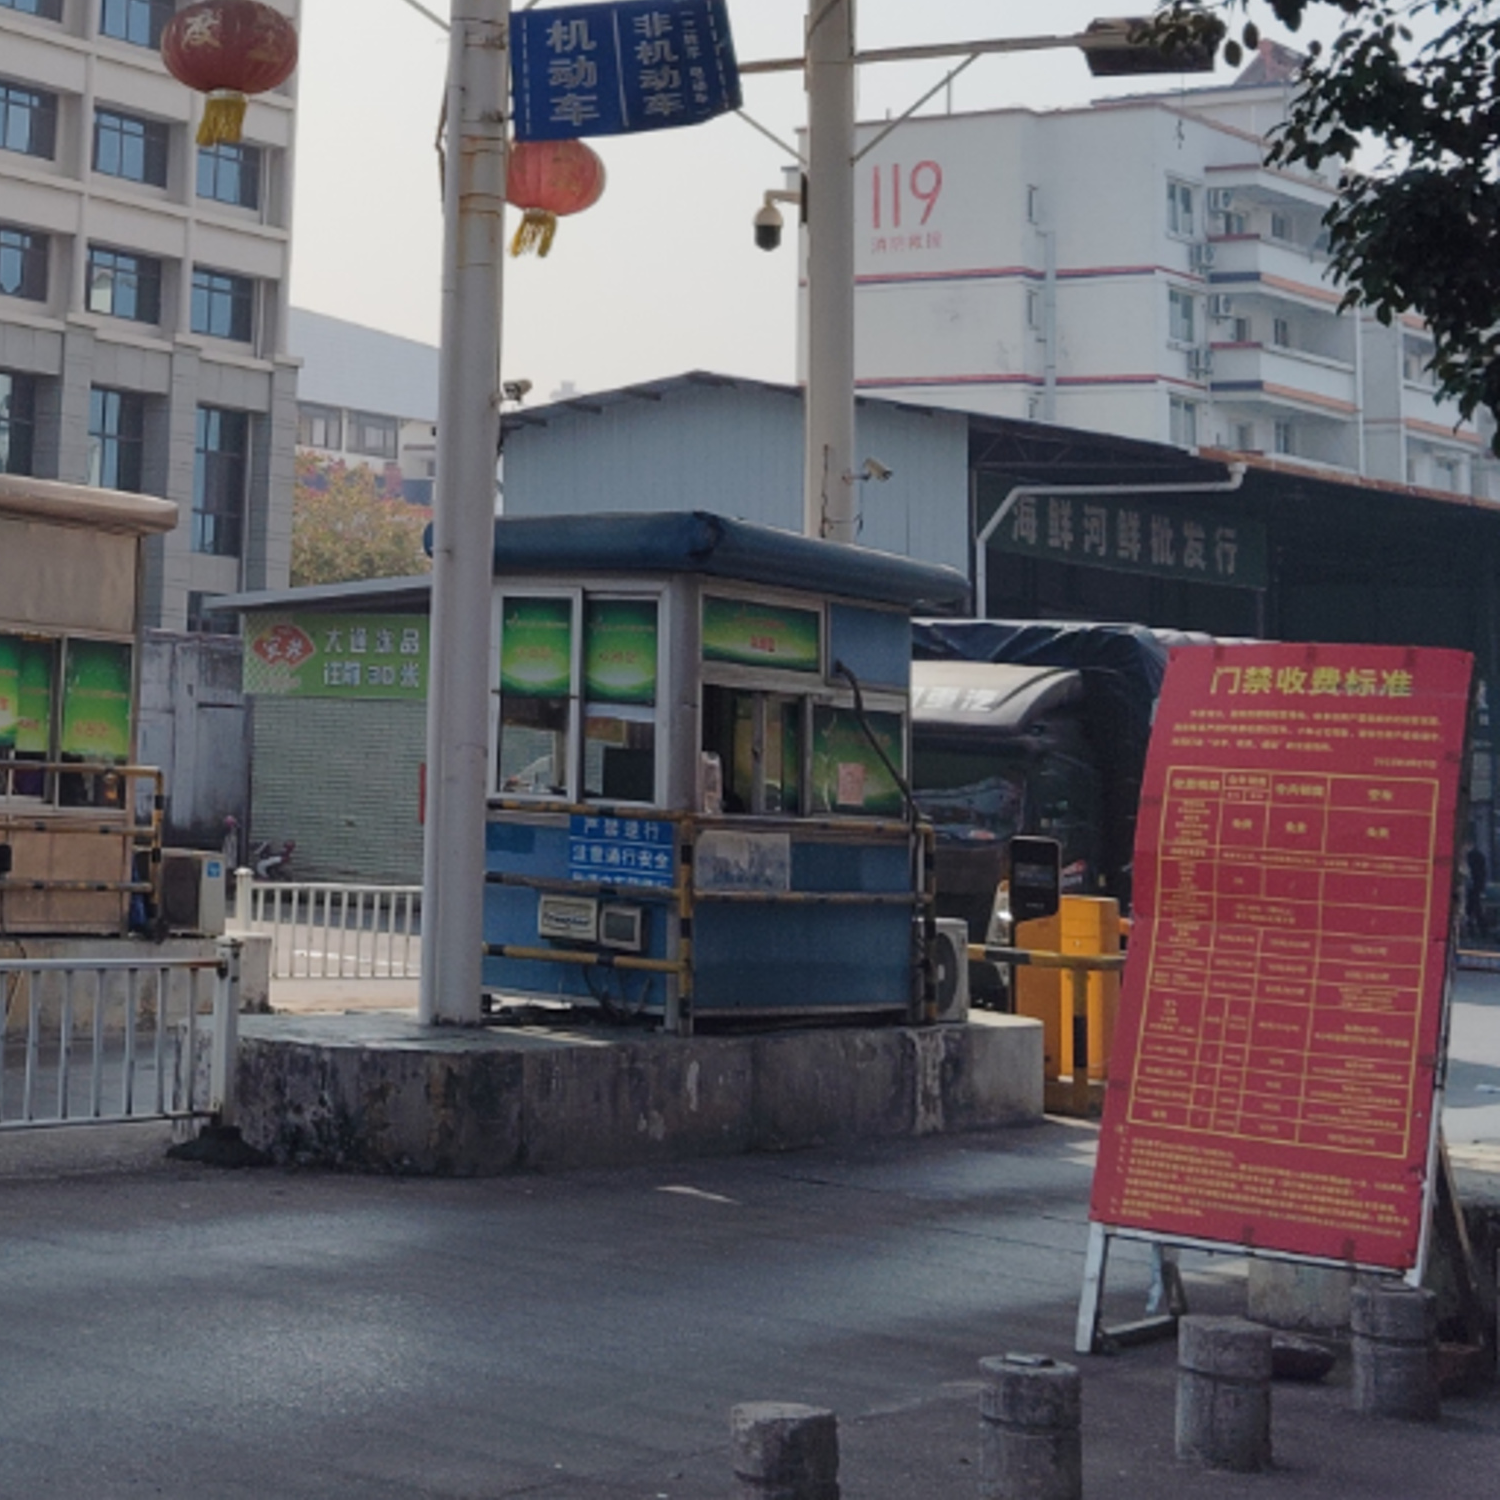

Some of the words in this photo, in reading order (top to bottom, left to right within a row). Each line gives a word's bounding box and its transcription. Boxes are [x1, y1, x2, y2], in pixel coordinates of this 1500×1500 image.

[546, 19, 601, 126] 机动车
[633, 11, 685, 116] 非机动车
[872, 160, 943, 230] 119
[1012, 496, 1238, 576] 海鲜河鲜批发行
[1210, 666, 1414, 698] 门禁收费标准
